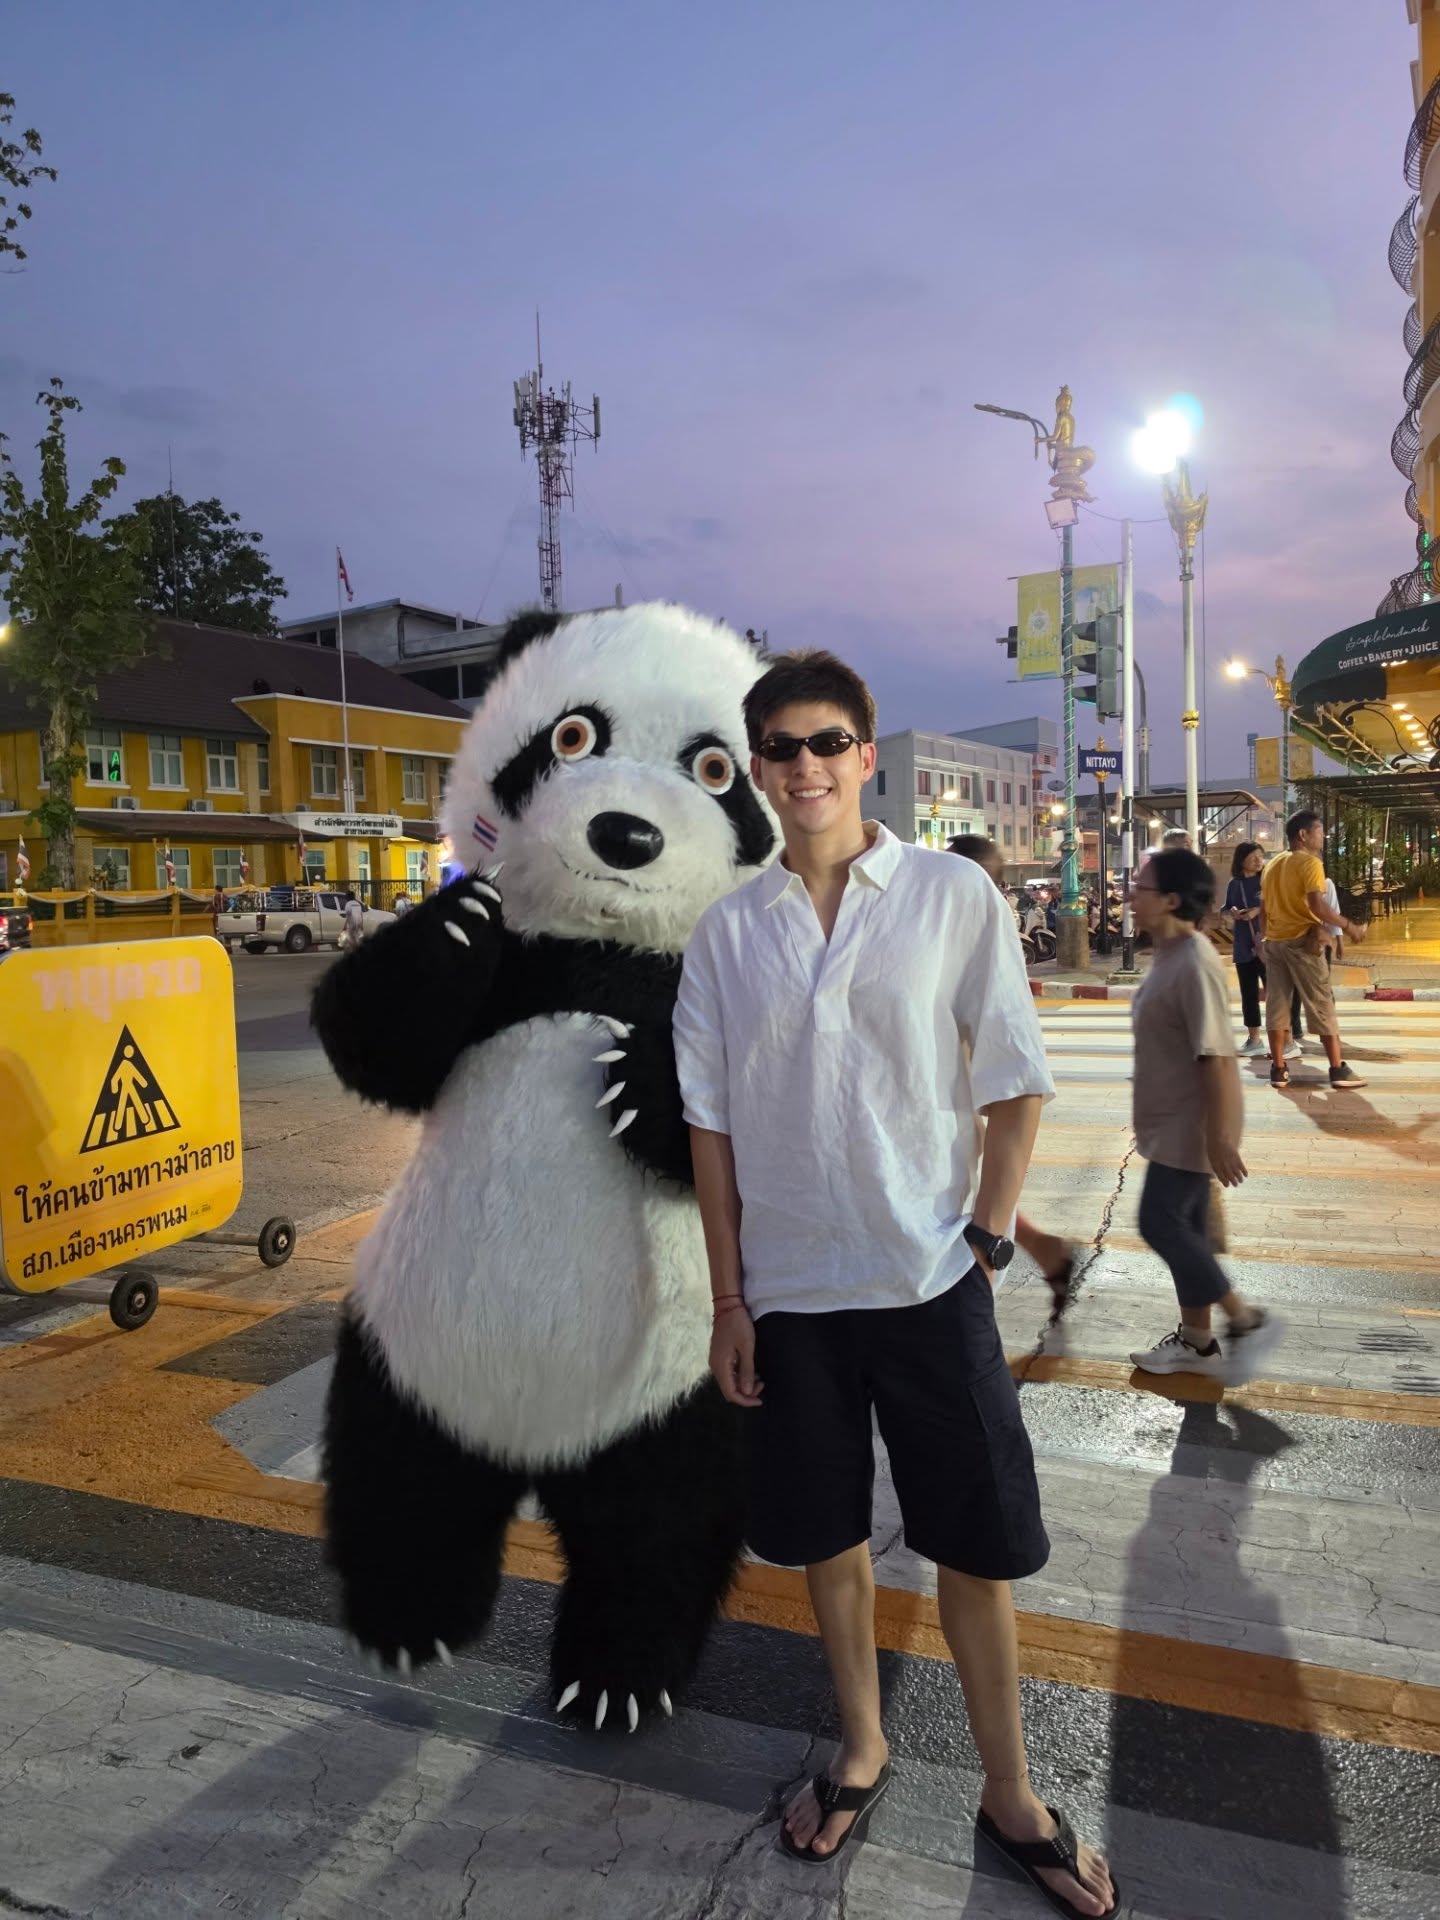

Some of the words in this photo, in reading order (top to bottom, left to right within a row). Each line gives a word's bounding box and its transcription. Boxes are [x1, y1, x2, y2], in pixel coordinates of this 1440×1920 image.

[1338, 656, 1364, 669] COFFEE
[1368, 648, 1403, 662] BAKERY
[1409, 641, 1439, 655] JUICE
[1086, 756, 1117, 768] NITTAYO
[14, 1140, 235, 1224] ให้คนข้ามทางม้าลาย
[23, 1204, 188, 1279] สภ.เมืองนครพนม
